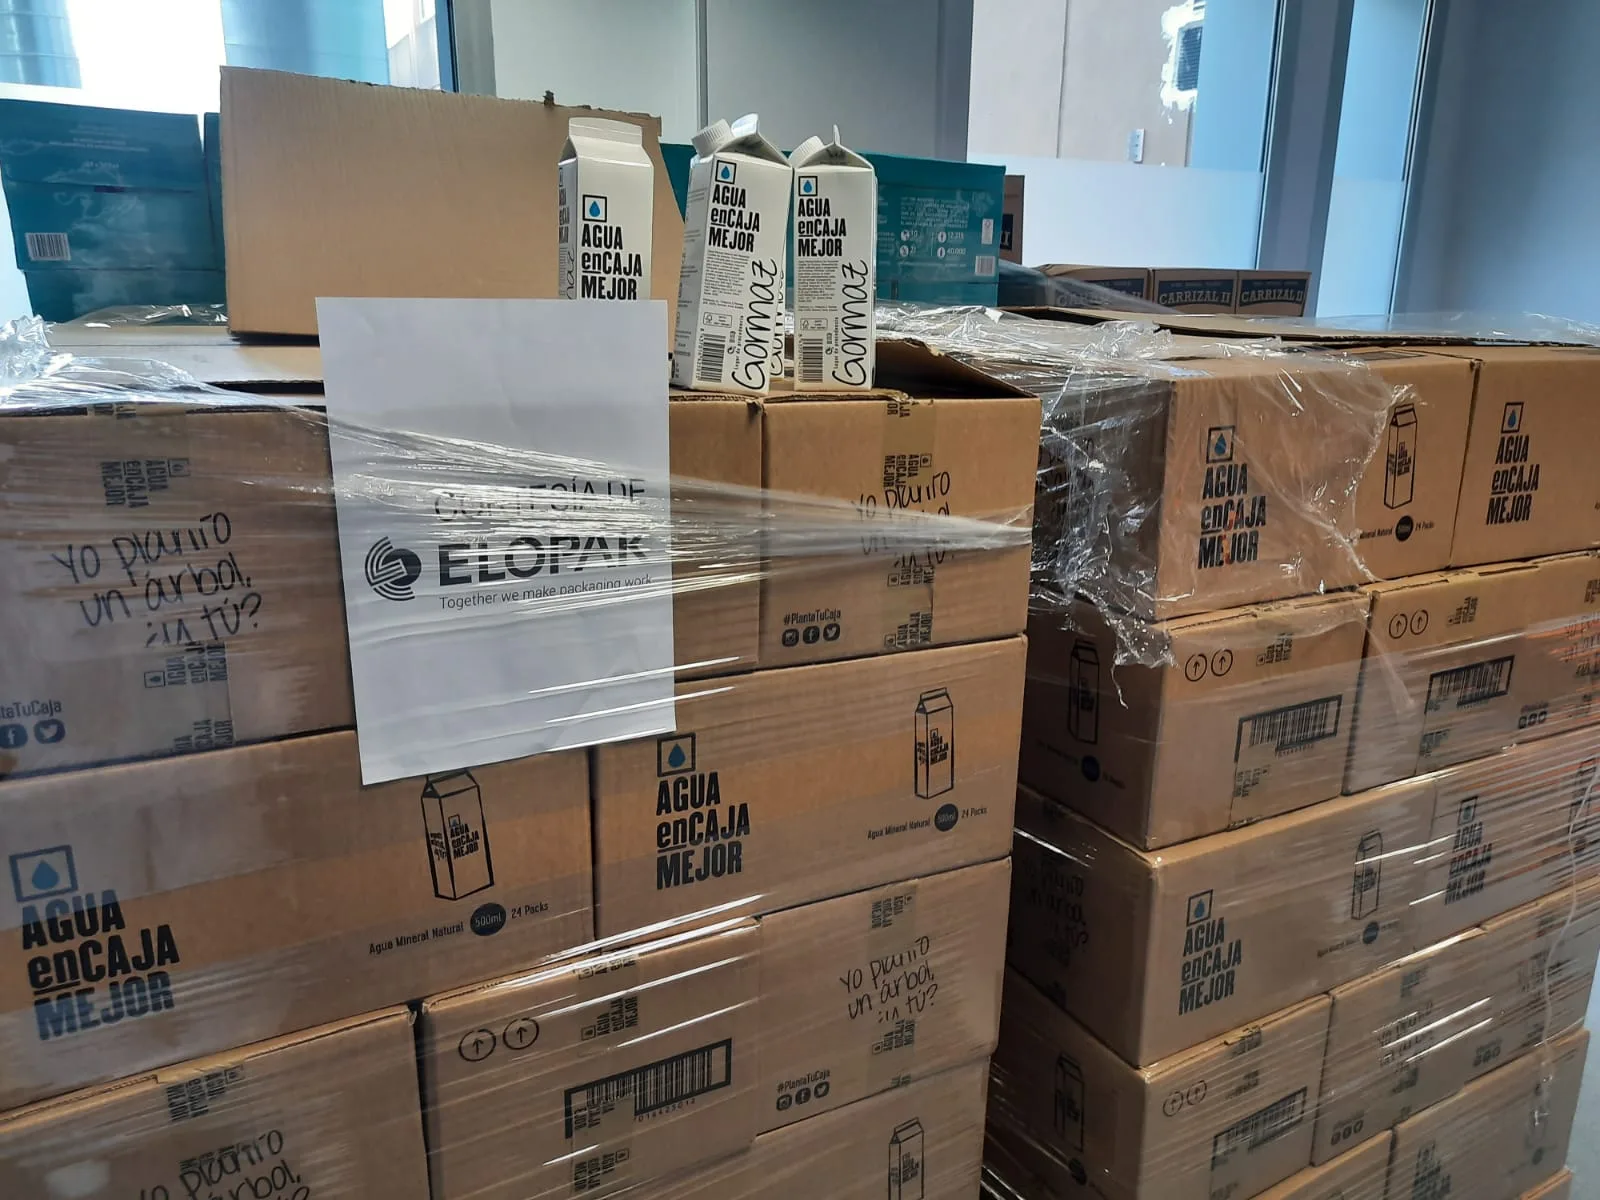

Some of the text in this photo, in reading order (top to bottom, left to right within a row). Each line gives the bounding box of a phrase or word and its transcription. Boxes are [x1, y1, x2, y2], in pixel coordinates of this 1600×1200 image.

[712, 184, 746, 208] AGUA
[798, 198, 830, 217] AGUA
[581, 223, 623, 250] AGUA
[711, 207, 760, 232] enCAJA
[798, 218, 846, 237] enCAJA
[708, 227, 755, 252] MEJOR
[798, 238, 842, 257] MEJOR
[581, 251, 642, 277] enCAJA
[581, 275, 637, 300] MEJOR
[1160, 290, 1219, 305] CARRIZAL
[1241, 288, 1294, 302] CARRIZAL
[732, 258, 777, 390] Gormaz
[832, 259, 868, 386] Gormaz
[1495, 435, 1530, 464] AGUA
[1203, 463, 1248, 499] AGUA
[1491, 463, 1540, 496] enCAJA
[1200, 495, 1266, 535] enCAJA
[1486, 494, 1532, 526] MEJOR
[438, 532, 650, 586] ELOPAK
[1197, 530, 1258, 569] MEJOR
[80, 588, 132, 627] un
[439, 594, 497, 611] Together
[501, 592, 519, 602] we
[523, 586, 556, 600] make
[560, 578, 621, 595] packaging
[656, 771, 721, 816] AGUA
[656, 803, 751, 853] enCAJA
[867, 829, 884, 840] Agua
[656, 840, 743, 891] MEJOR
[21, 888, 126, 950] AGUA
[368, 941, 394, 955] Agua
[395, 929, 430, 948] Mineral
[432, 921, 464, 939] Natural
[510, 906, 522, 920] 24
[524, 901, 549, 916] Packs
[1183, 916, 1226, 957] AGUA
[27, 924, 180, 996] enCAJA
[1181, 939, 1242, 986] enCAJA
[33, 970, 175, 1041] MEJOR
[848, 993, 873, 1020] un
[1178, 970, 1236, 1016] MEJOR
